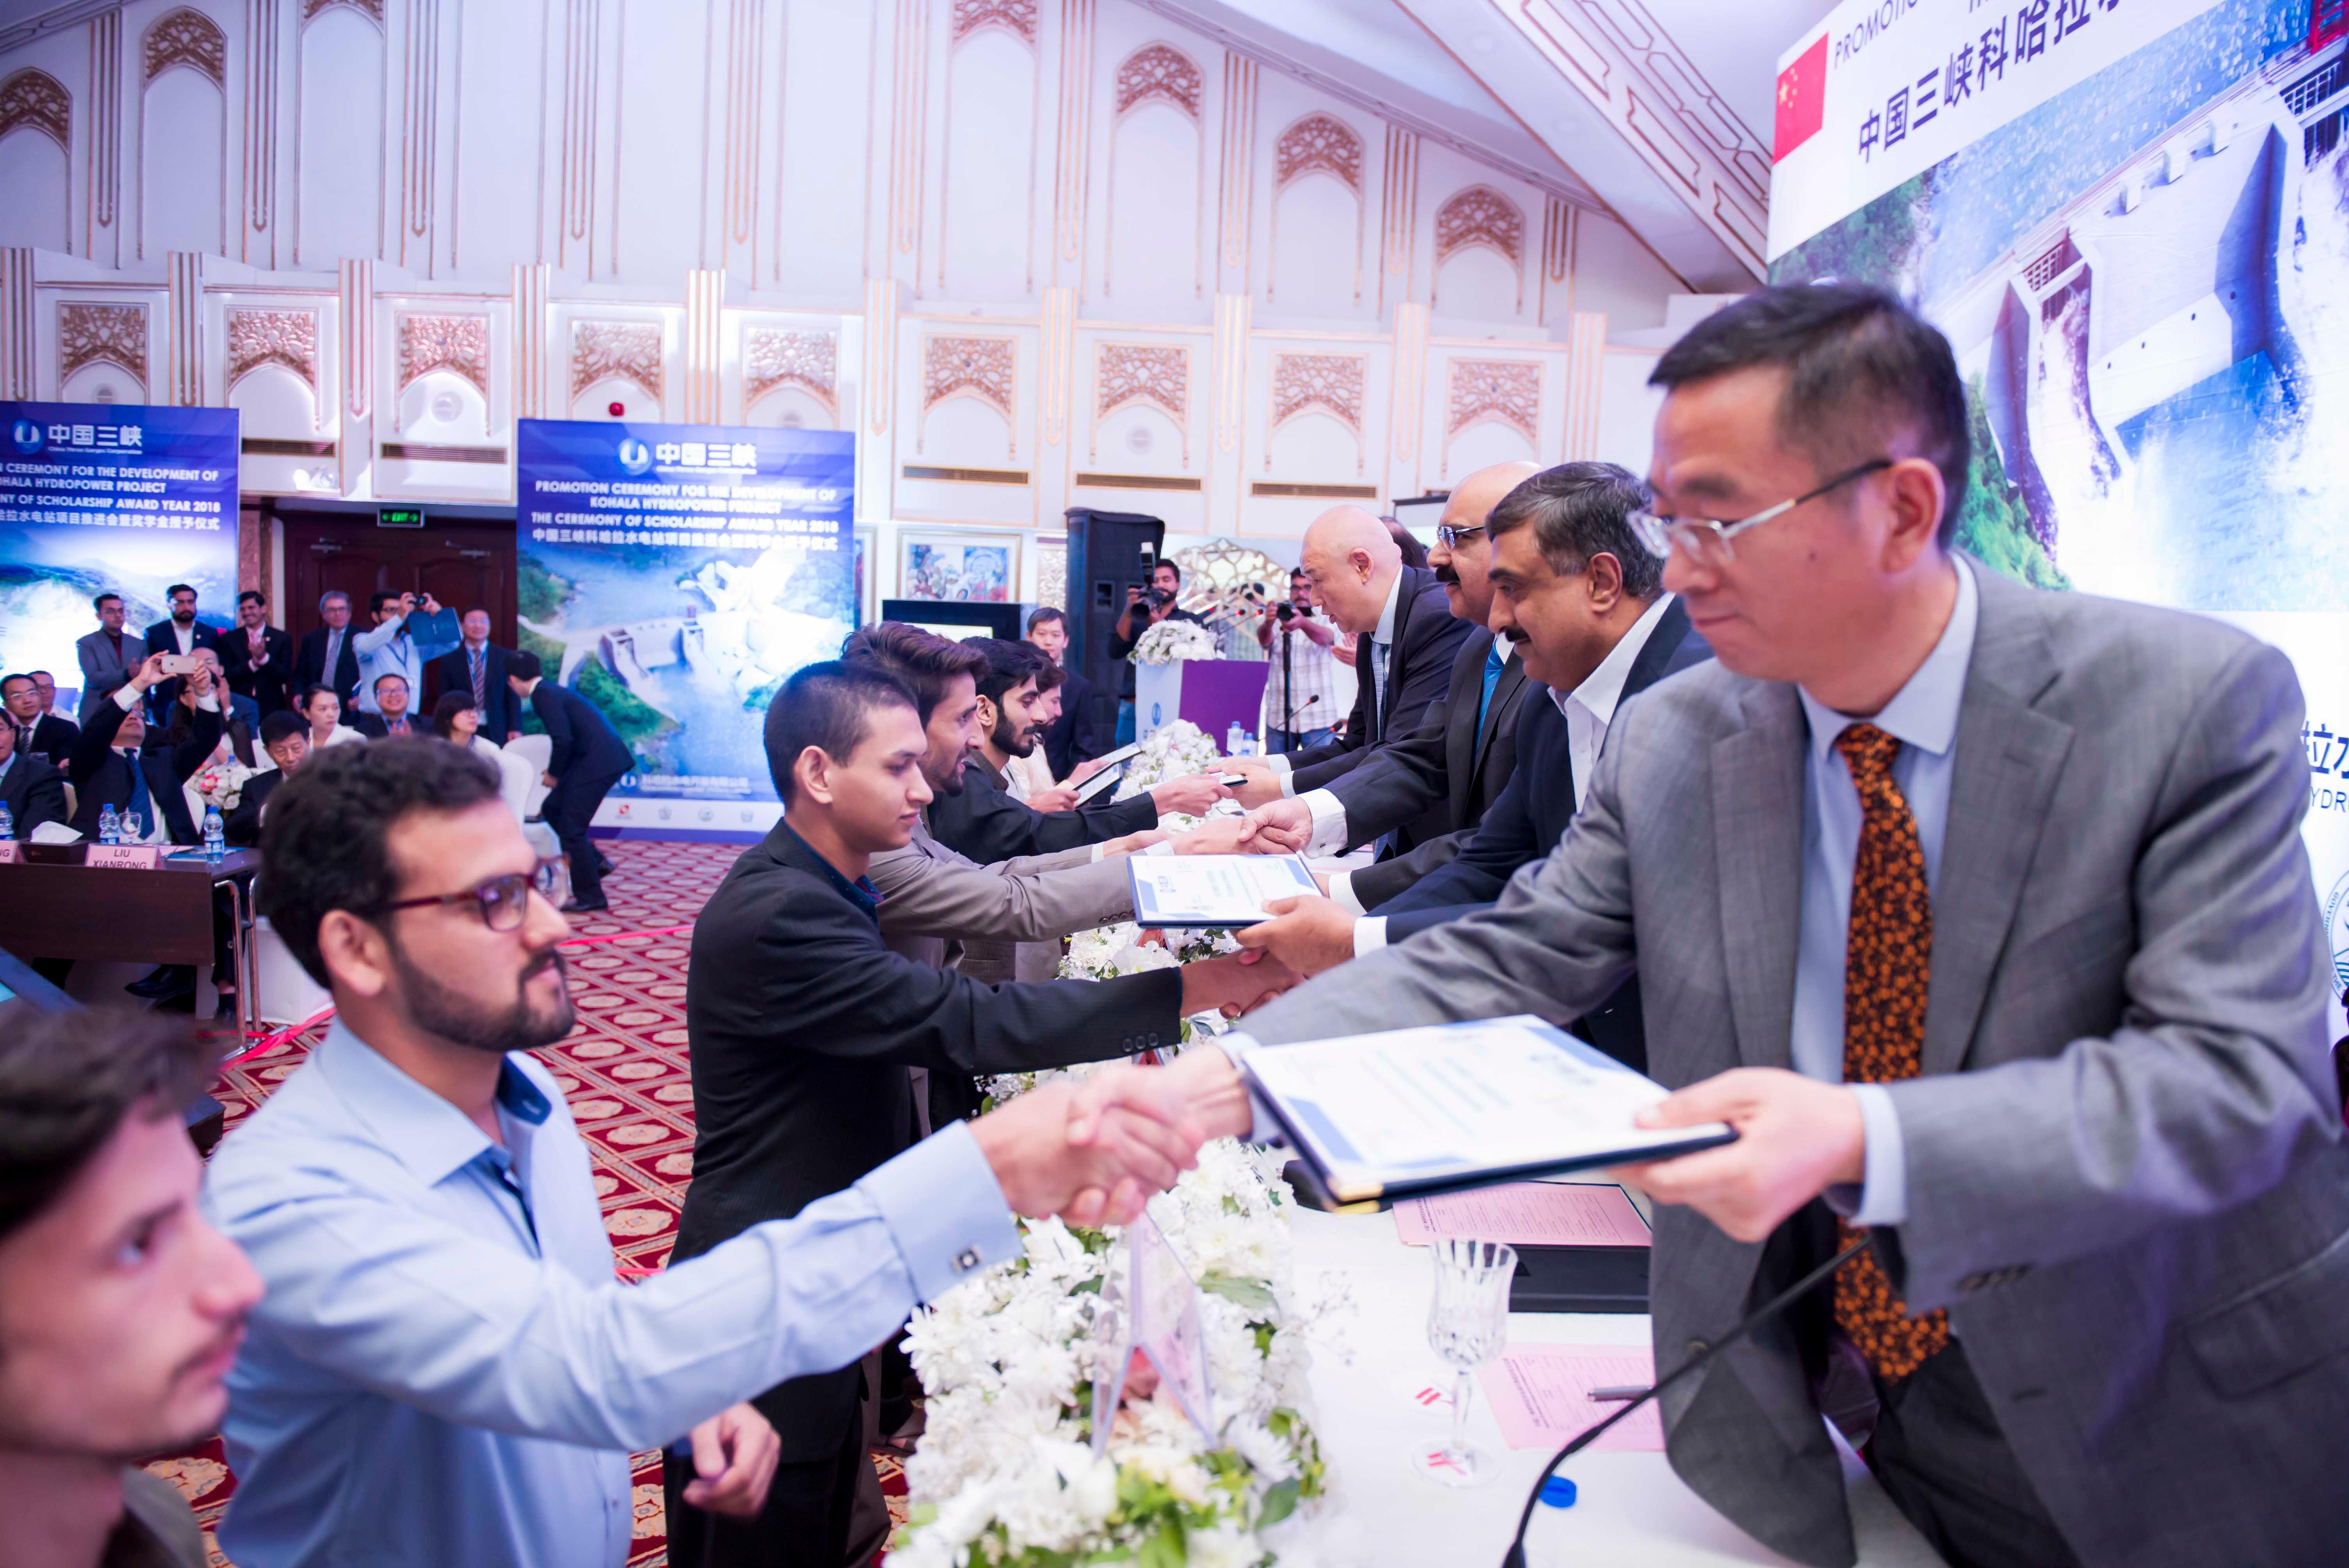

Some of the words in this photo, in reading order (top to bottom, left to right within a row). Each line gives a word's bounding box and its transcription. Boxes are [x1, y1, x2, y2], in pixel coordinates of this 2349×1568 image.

[1858, 0, 2119, 163] 中国三峡科哈拉
[48, 424, 142, 447] 中国三峡
[656, 442, 757, 467] 中国三峡
[6, 463, 69, 475] CEREMONY
[72, 466, 94, 476] FOR
[97, 467, 116, 477] THE
[119, 467, 200, 481] DEVELOPMENT
[202, 470, 219, 481] OF
[0, 477, 32, 487] HALA
[35, 478, 114, 491] HYDROPOWER
[117, 481, 166, 493] PROJECT
[535, 481, 609, 494] PROMOTION
[611, 483, 679, 496] CEREMONY
[818, 489, 836, 501] OF
[18, 494, 34, 504] OF
[36, 495, 113, 508] SCHOLARSHIP
[116, 498, 159, 510] AWARD
[162, 500, 191, 511] YEAR
[193, 501, 221, 513] 2018
[590, 497, 640, 509] KOHALA
[531, 512, 552, 524] THE
[554, 513, 622, 526] CEREMONY
[625, 514, 643, 527] OF
[2311, 786, 2349, 813] YDR
[94, 860, 146, 869] XIANRONG
